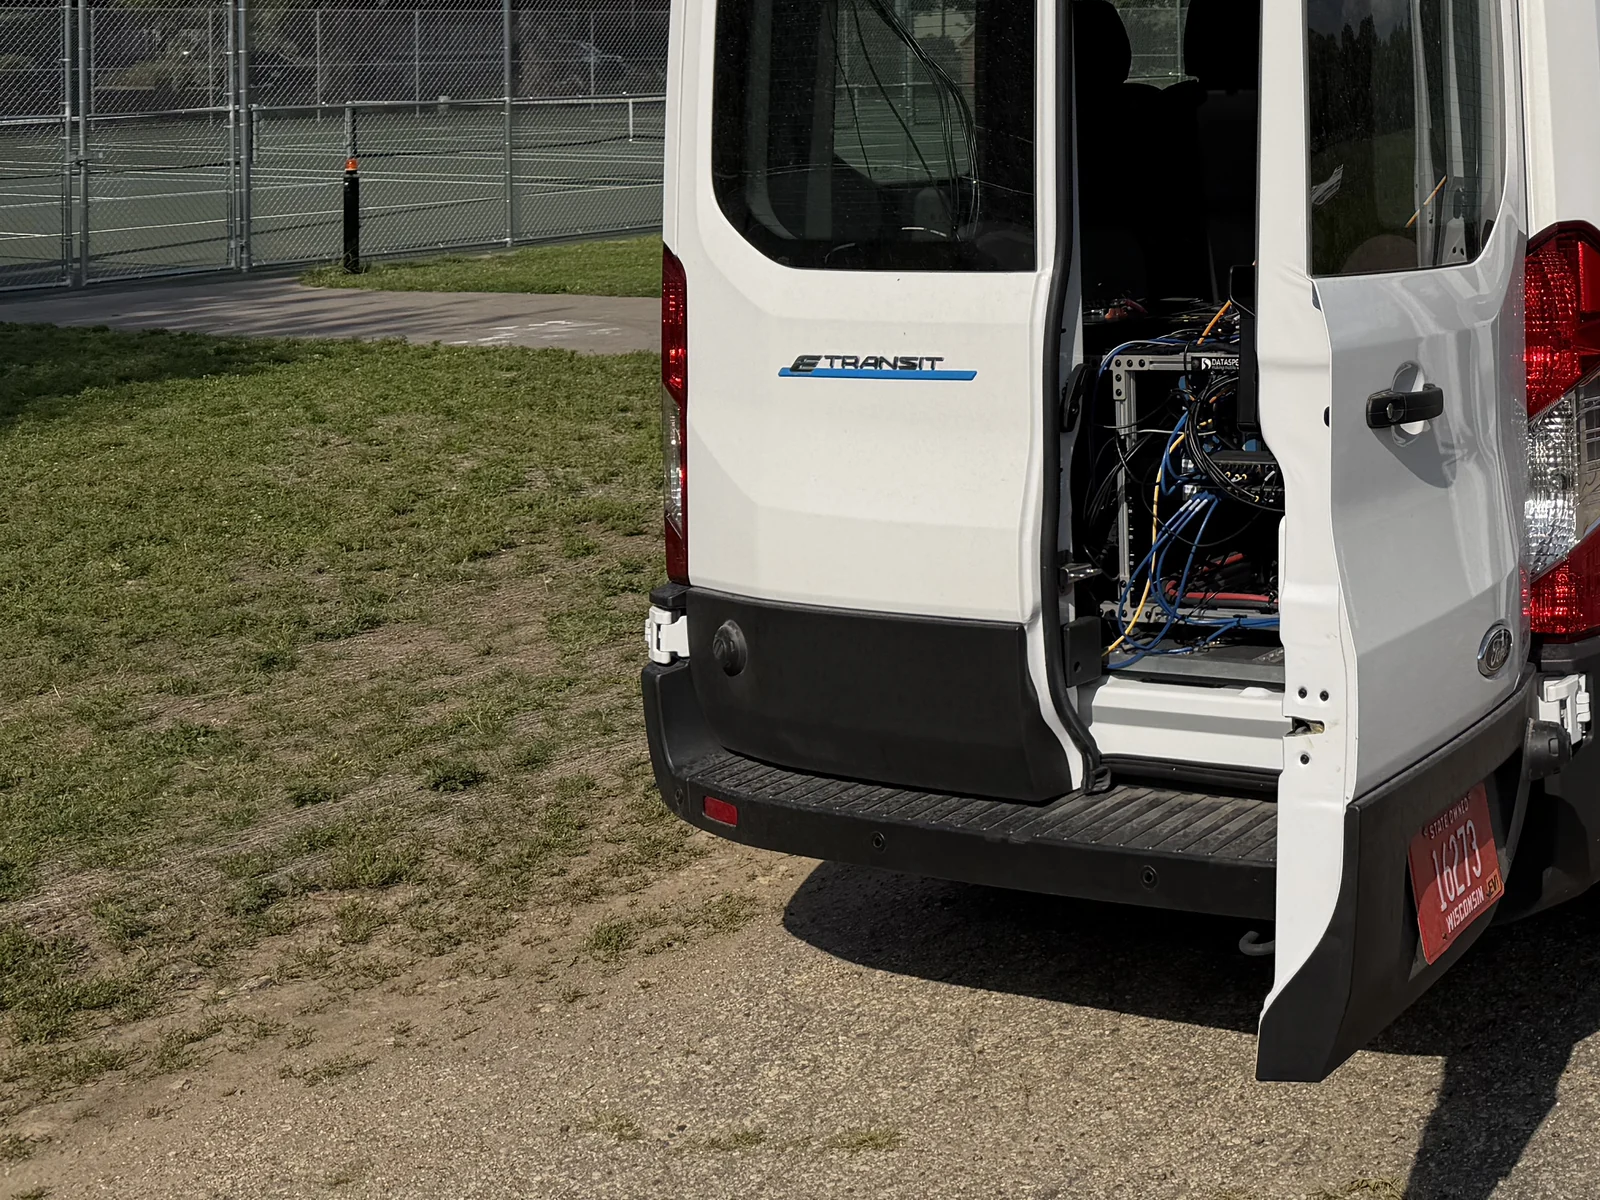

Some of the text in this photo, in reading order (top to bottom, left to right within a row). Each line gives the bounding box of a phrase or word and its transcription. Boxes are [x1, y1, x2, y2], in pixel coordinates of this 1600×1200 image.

[1429, 797, 1469, 839] STATE OWNED
[1432, 819, 1482, 913] 16273
[1445, 885, 1485, 934] WISCONSIN
